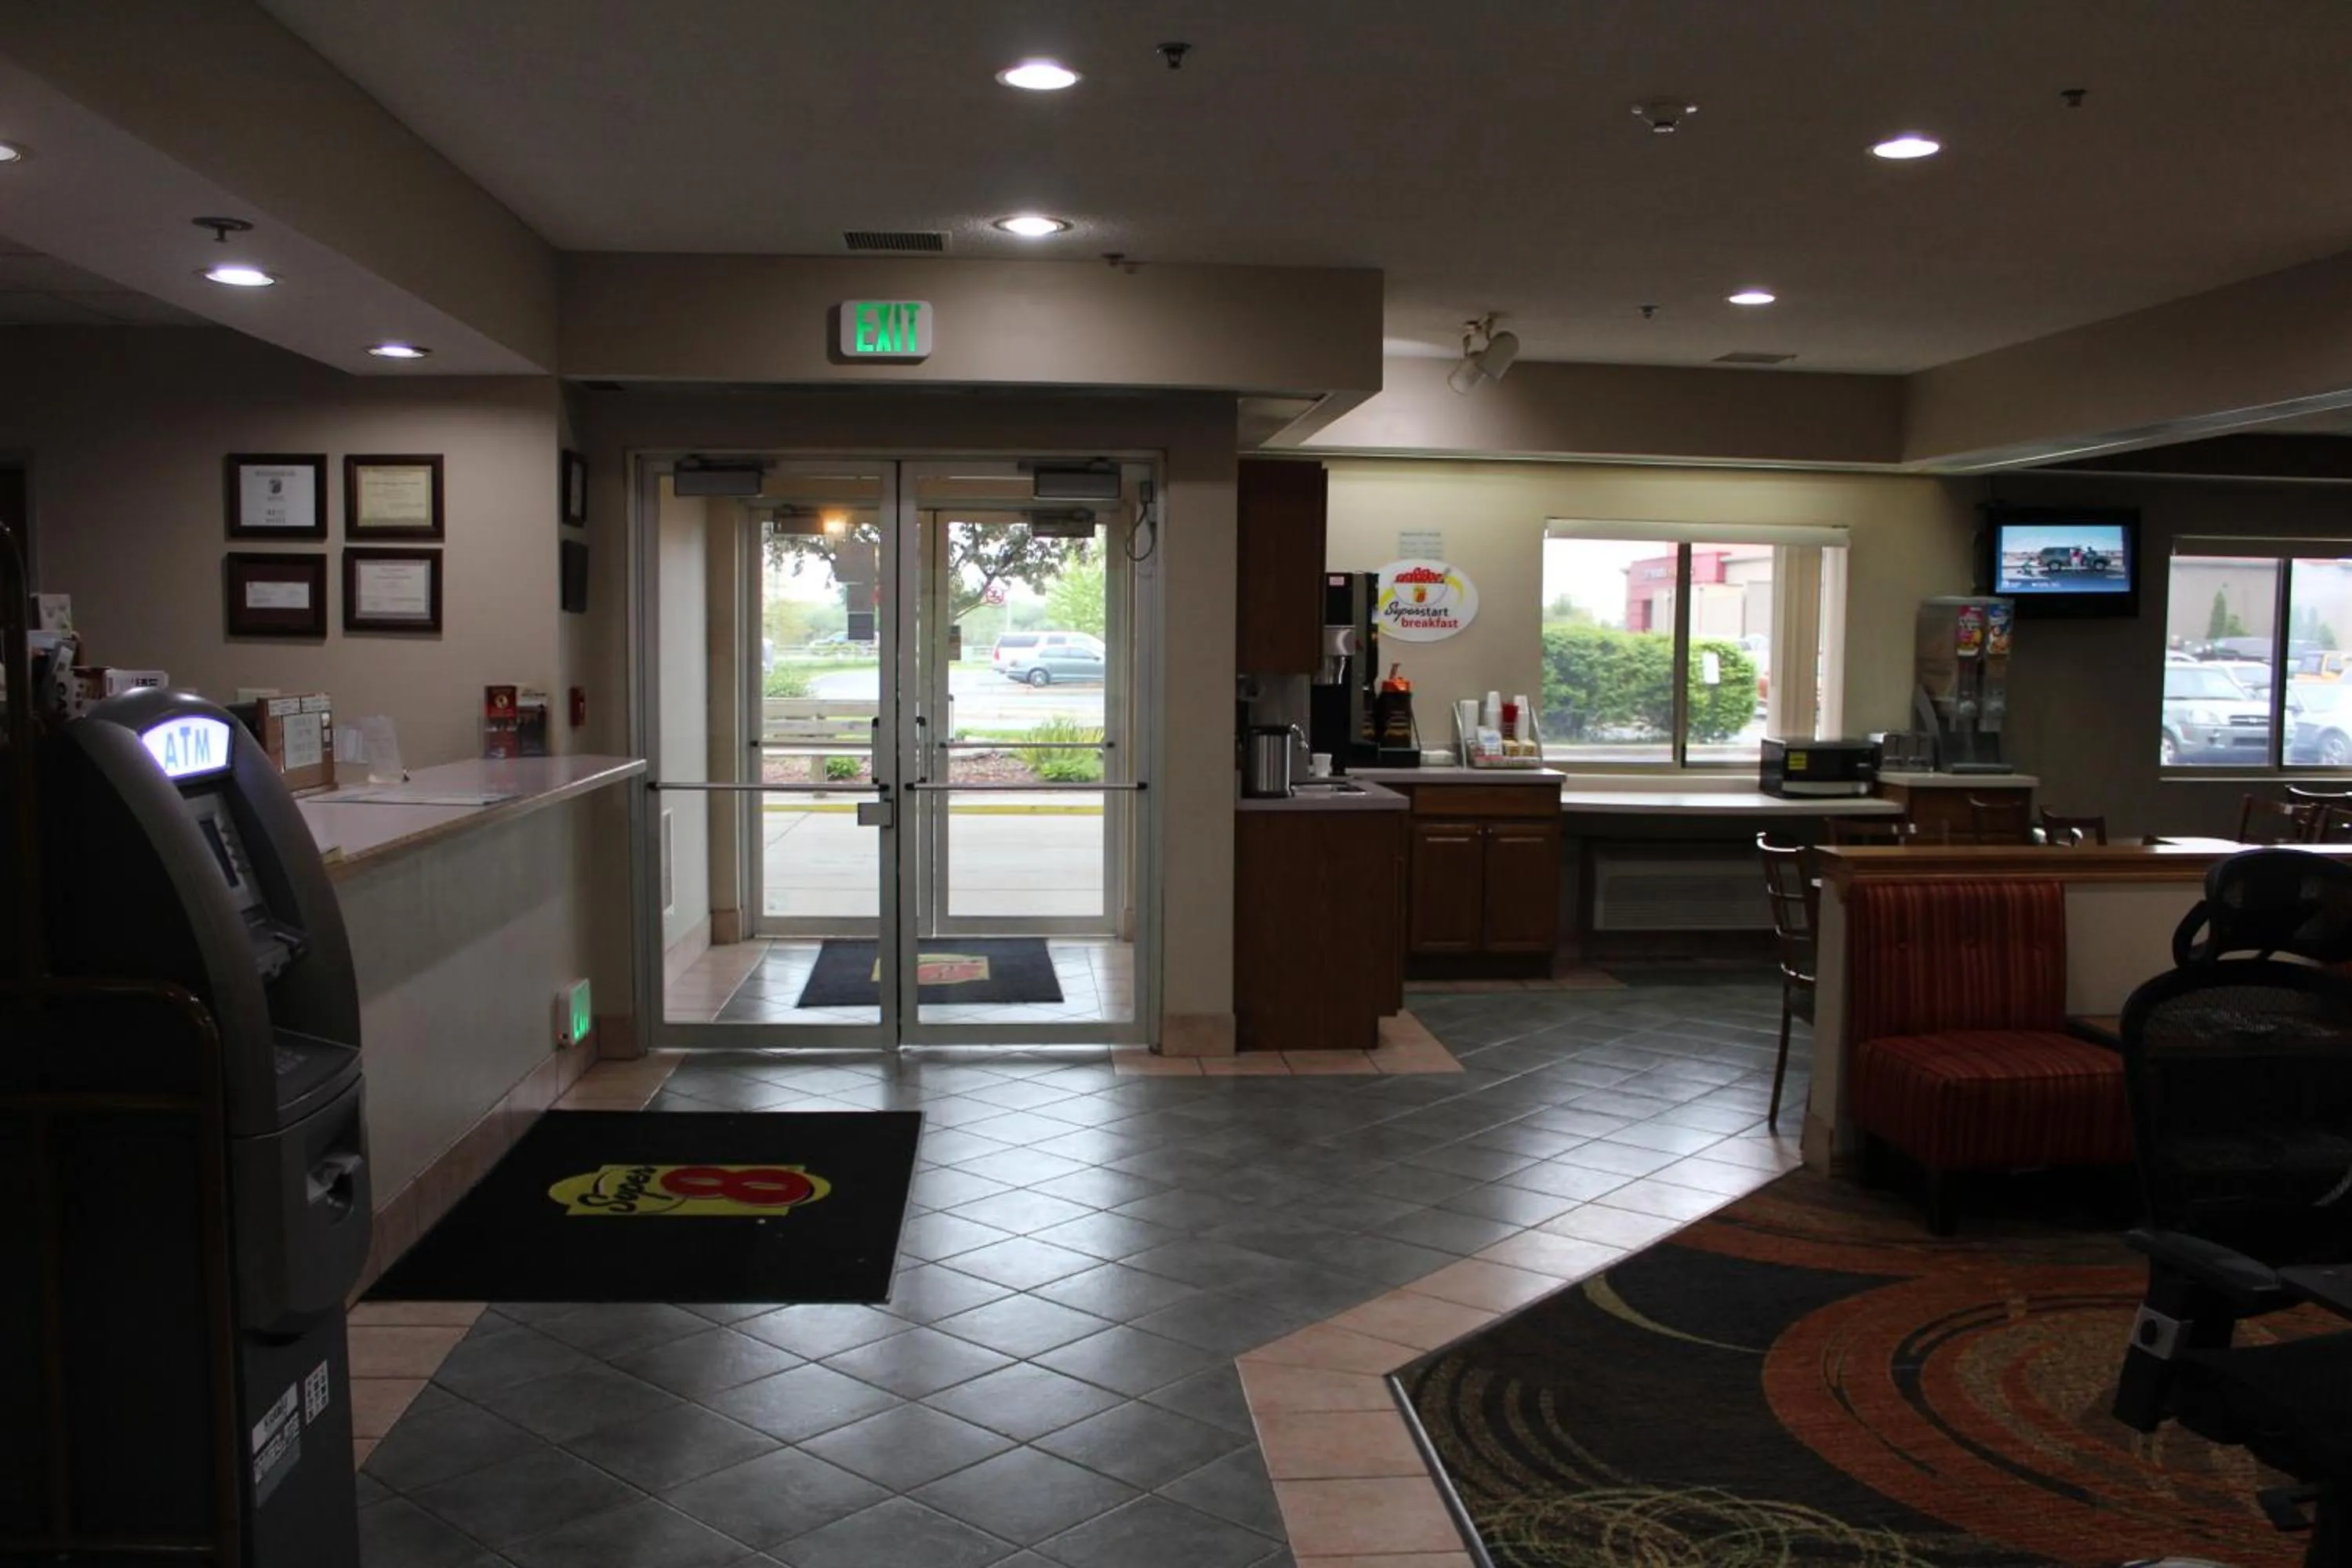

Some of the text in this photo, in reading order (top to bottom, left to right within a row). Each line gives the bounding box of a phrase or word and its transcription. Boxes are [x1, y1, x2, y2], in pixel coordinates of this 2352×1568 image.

[856, 303, 920, 352] EXIT
[1401, 617, 1458, 628] breakfast
[165, 726, 210, 768] ATM
[660, 1167, 815, 1206] 8
